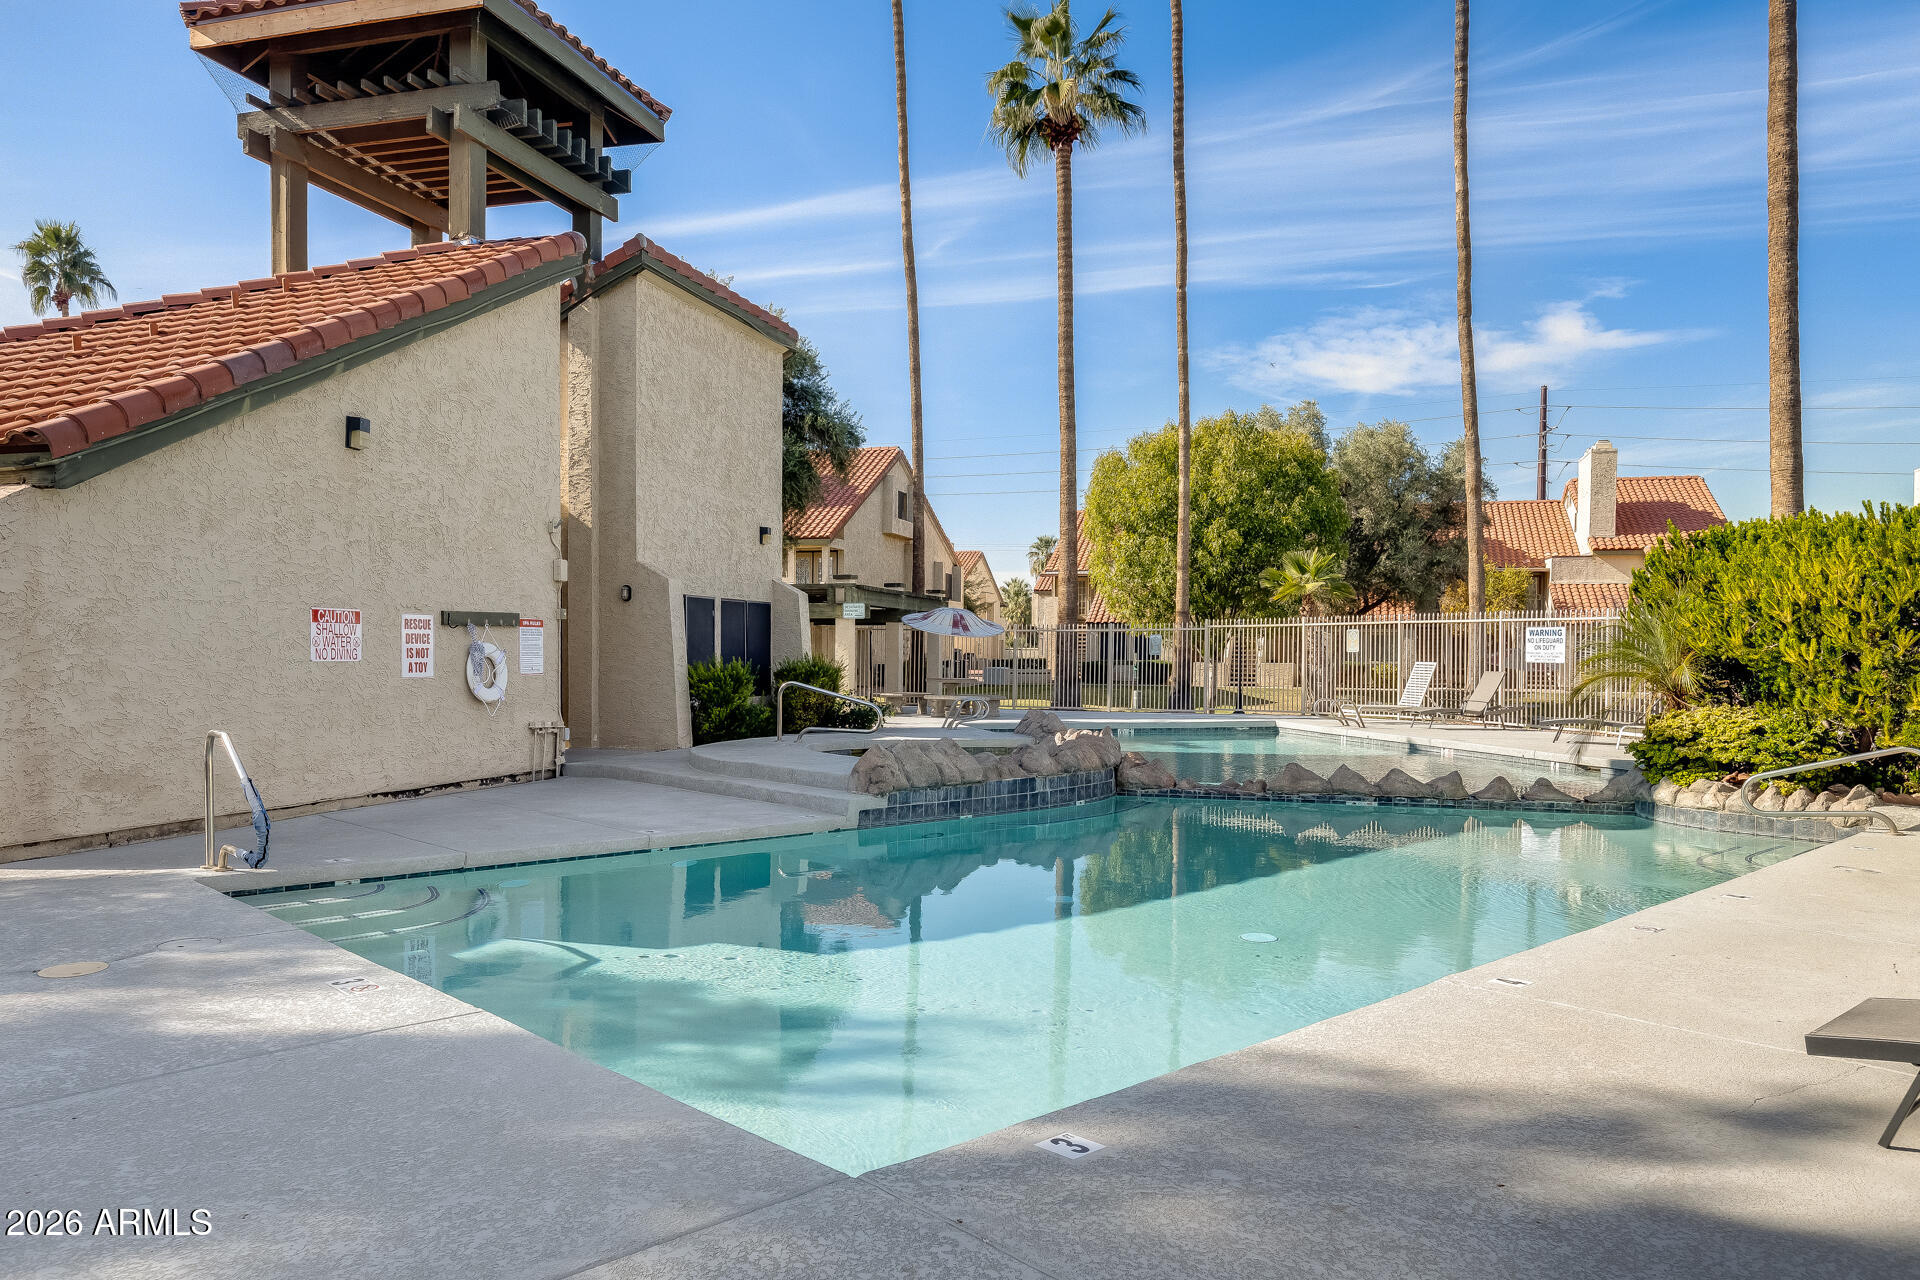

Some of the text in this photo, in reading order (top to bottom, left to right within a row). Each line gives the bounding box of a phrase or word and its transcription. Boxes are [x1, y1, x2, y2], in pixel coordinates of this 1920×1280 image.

[318, 610, 356, 623] CAUTION
[315, 623, 357, 636] SHALLOW
[404, 618, 431, 630] RESCUE
[405, 633, 431, 645] DEVICE
[1528, 629, 1563, 637] WARNING
[322, 636, 351, 648] WATER
[315, 648, 358, 660] NO DIVING
[406, 647, 429, 659] IS NOT
[408, 661, 427, 673] A TOY
[1050, 1138, 1090, 1153] 3
